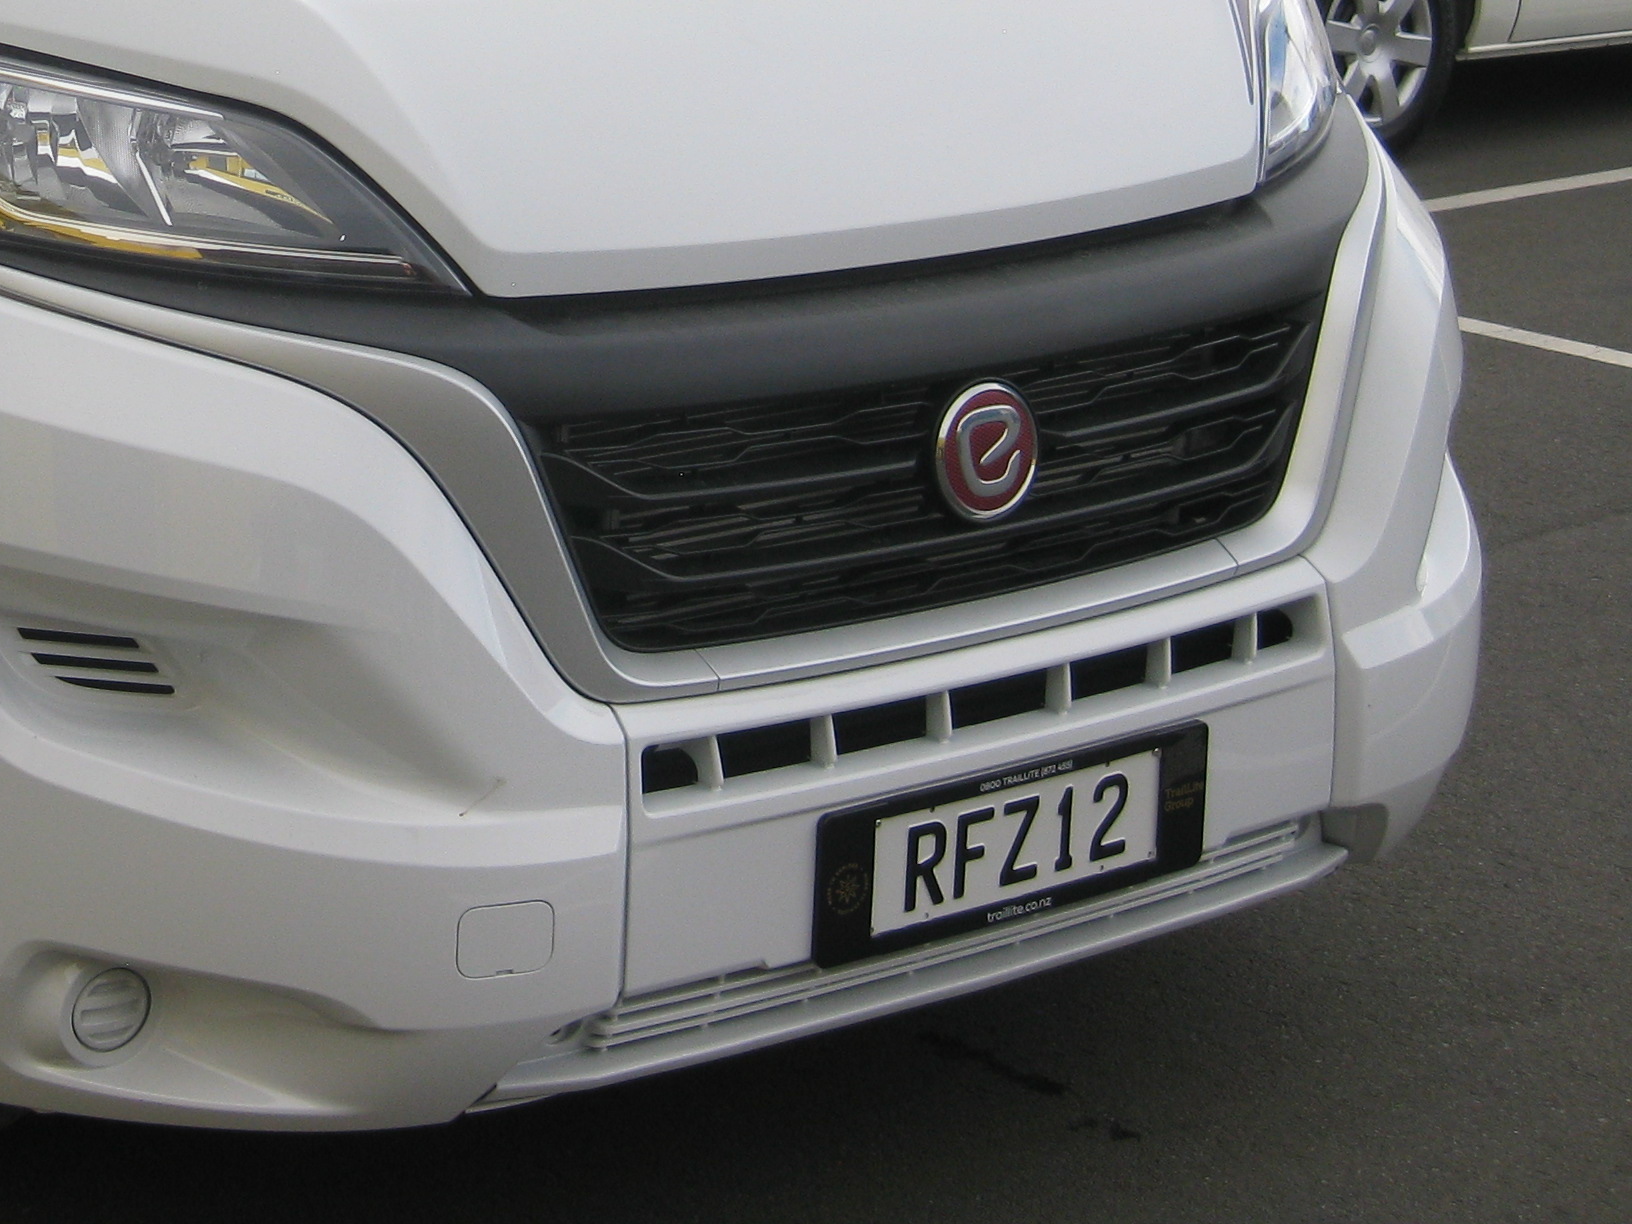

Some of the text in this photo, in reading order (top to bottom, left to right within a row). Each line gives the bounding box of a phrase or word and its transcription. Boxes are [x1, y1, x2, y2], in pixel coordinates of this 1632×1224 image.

[979, 779, 1003, 793] 0800
[1002, 768, 1041, 786] TRAILLITE
[1163, 797, 1195, 813] Group
[903, 771, 1130, 913] RFZ12
[986, 896, 1053, 923] traillite.co.nz
